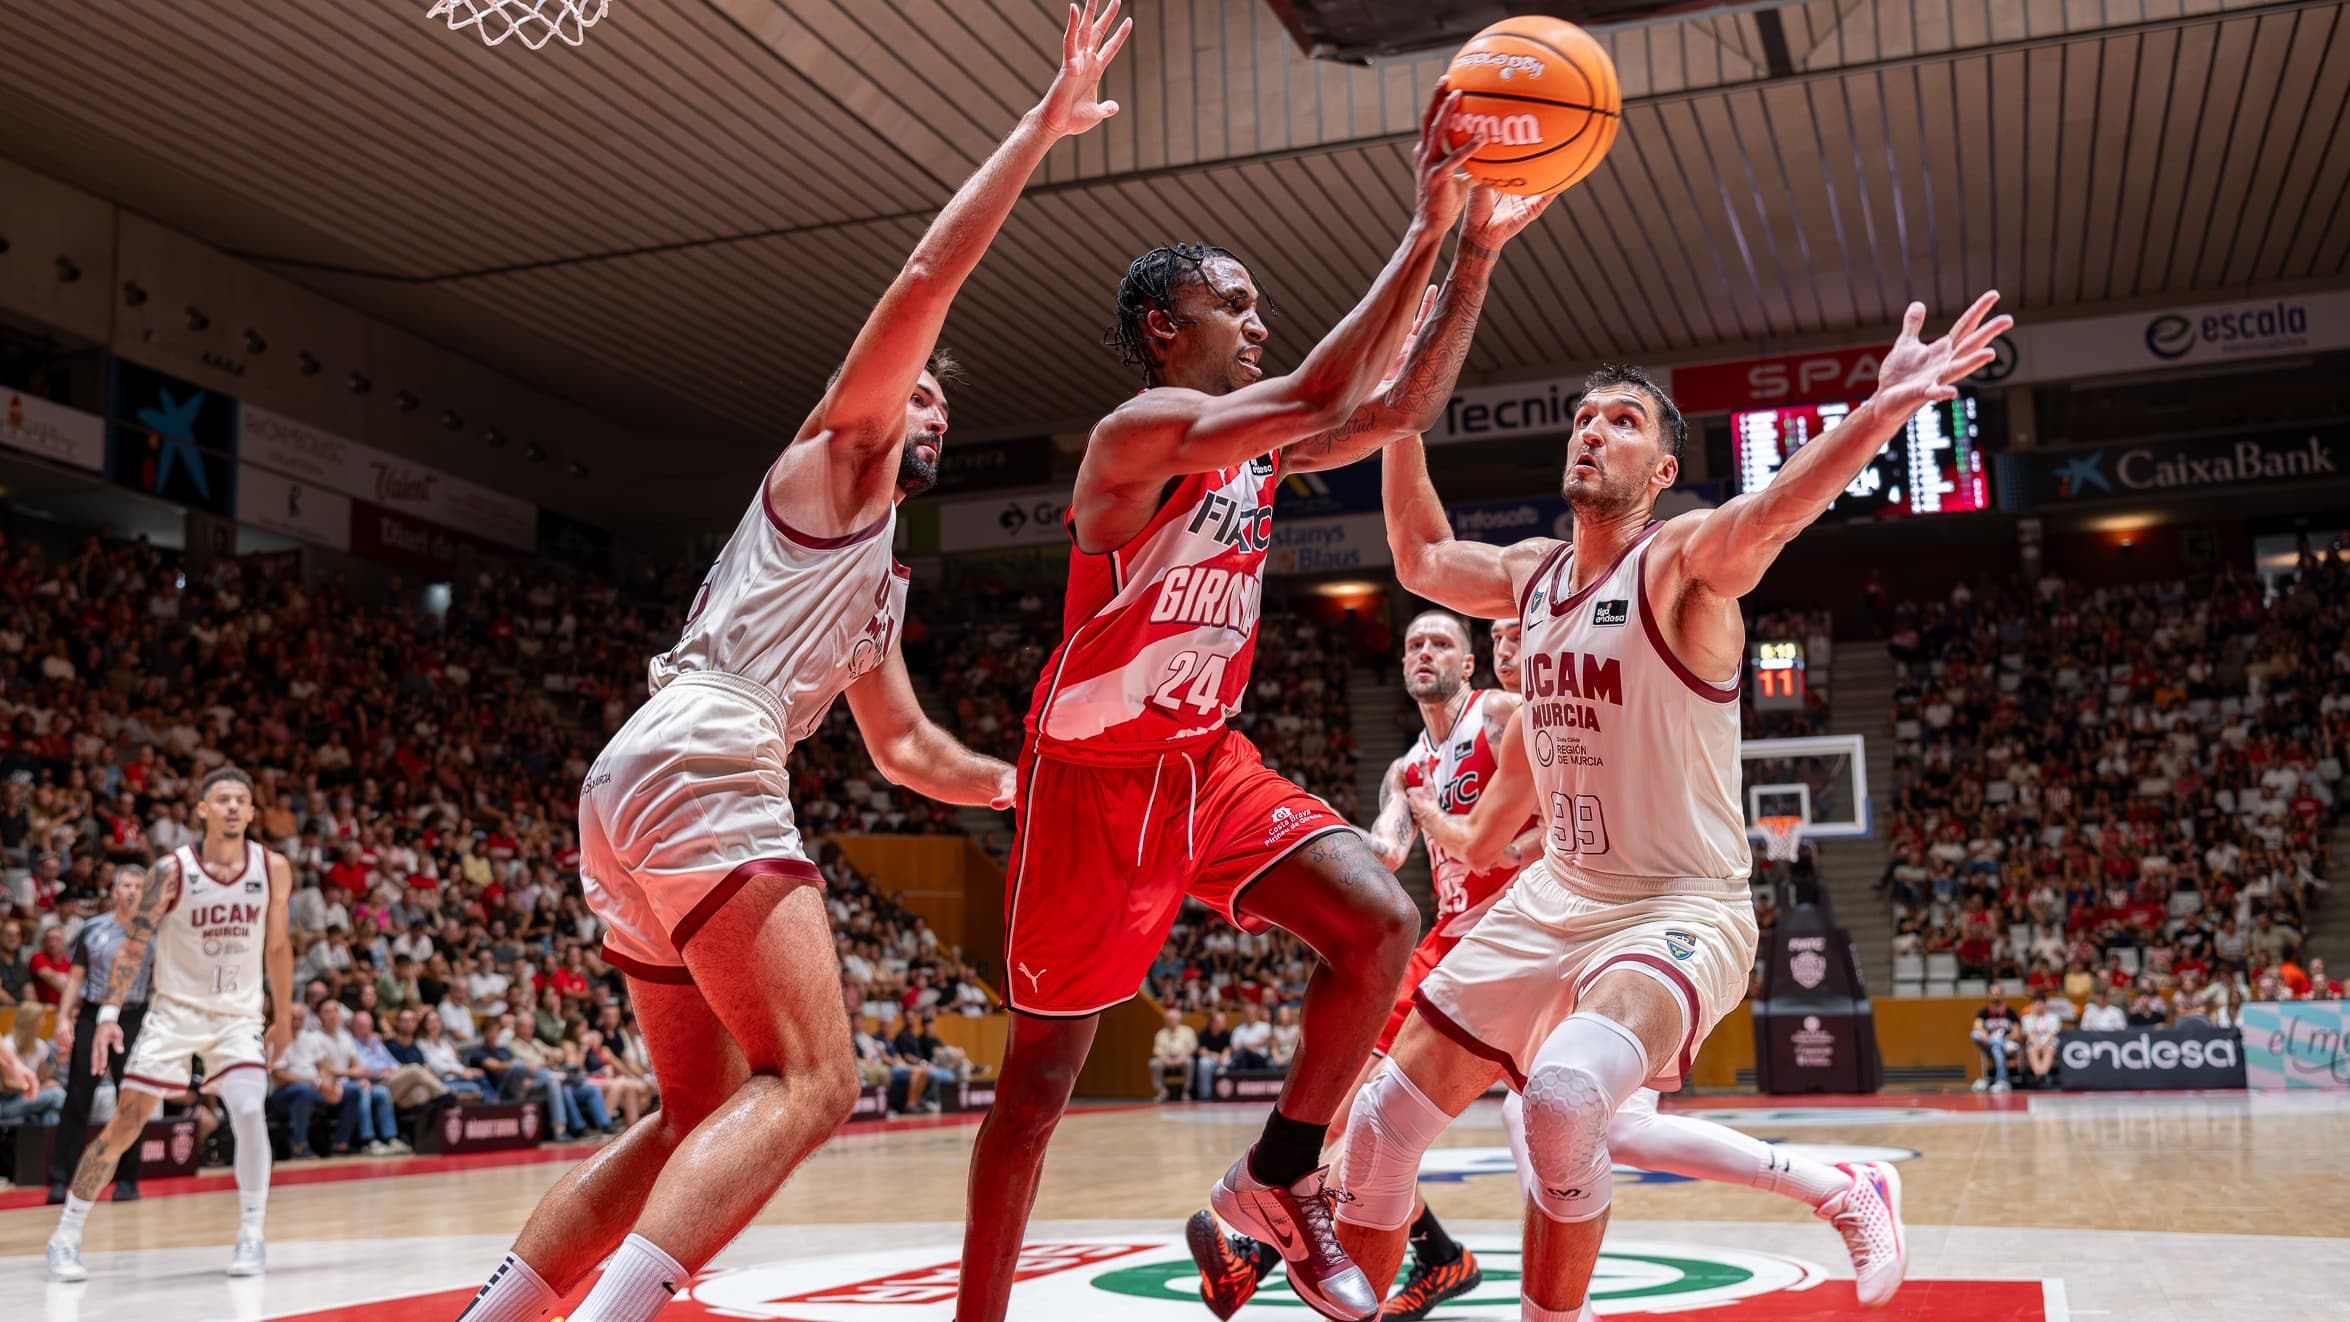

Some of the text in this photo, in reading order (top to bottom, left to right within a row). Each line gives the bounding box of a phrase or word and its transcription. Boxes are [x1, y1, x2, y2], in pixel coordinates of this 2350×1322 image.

[2201, 302, 2307, 342] escala
[1747, 353, 1881, 400] SPA
[2116, 434, 2337, 489] CaixaBank
[1152, 650, 1231, 716] 24
[1524, 651, 1623, 707] UCAM
[1757, 667, 1794, 698] 11
[1532, 703, 1601, 733] MURCIA
[1557, 743, 1587, 756] REGIÓN
[1558, 755, 1604, 767] DE MURCIA
[1264, 828, 1290, 847] Pirineu
[1268, 809, 1312, 836] Costa Brava
[1551, 791, 1611, 855] 99
[191, 903, 261, 928] UCAM
[2062, 1034, 2237, 1070] endesa
